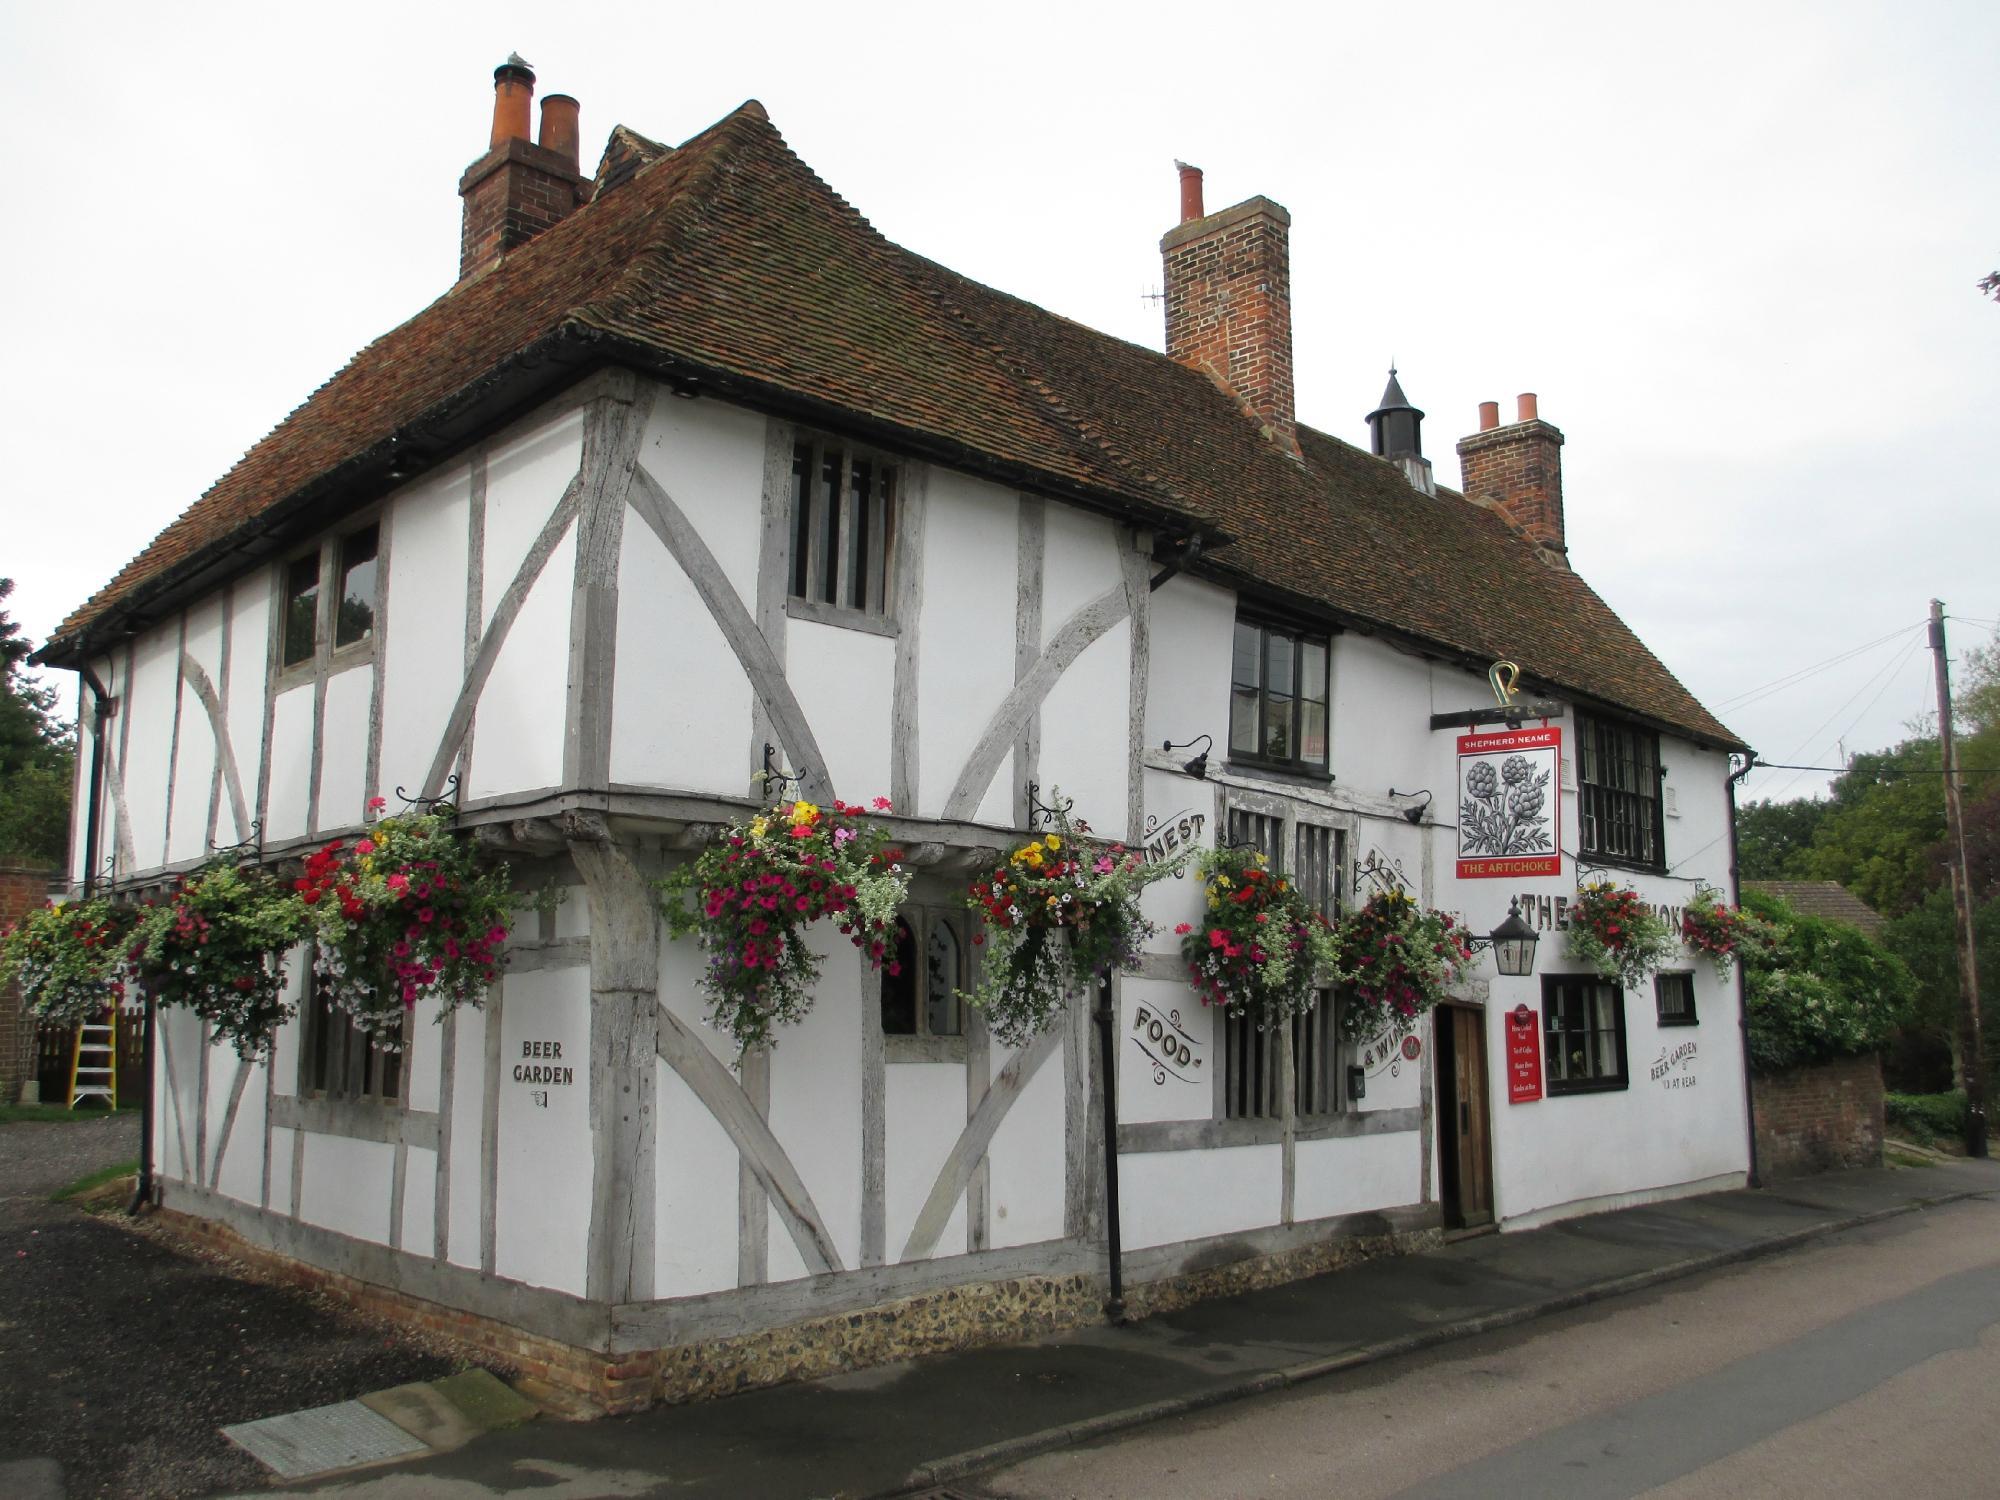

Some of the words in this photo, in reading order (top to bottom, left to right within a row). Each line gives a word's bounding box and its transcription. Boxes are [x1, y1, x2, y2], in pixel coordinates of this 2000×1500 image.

[1464, 737, 1515, 749] SHEPHERD
[1517, 733, 1551, 744] NEAME
[1143, 814, 1205, 867] INEST
[1462, 863, 1485, 874] THE
[1488, 860, 1553, 873] ARTICHOKE
[1519, 893, 1569, 931] THE
[522, 1040, 563, 1059] BEER
[1375, 1024, 1410, 1062] WIN
[1650, 1061, 1670, 1081] BEER
[1670, 1042, 1697, 1066] GARDEN
[513, 1064, 574, 1086] GARDEN
[1672, 1078, 1680, 1090] AT
[1681, 1076, 1696, 1088] REAR
